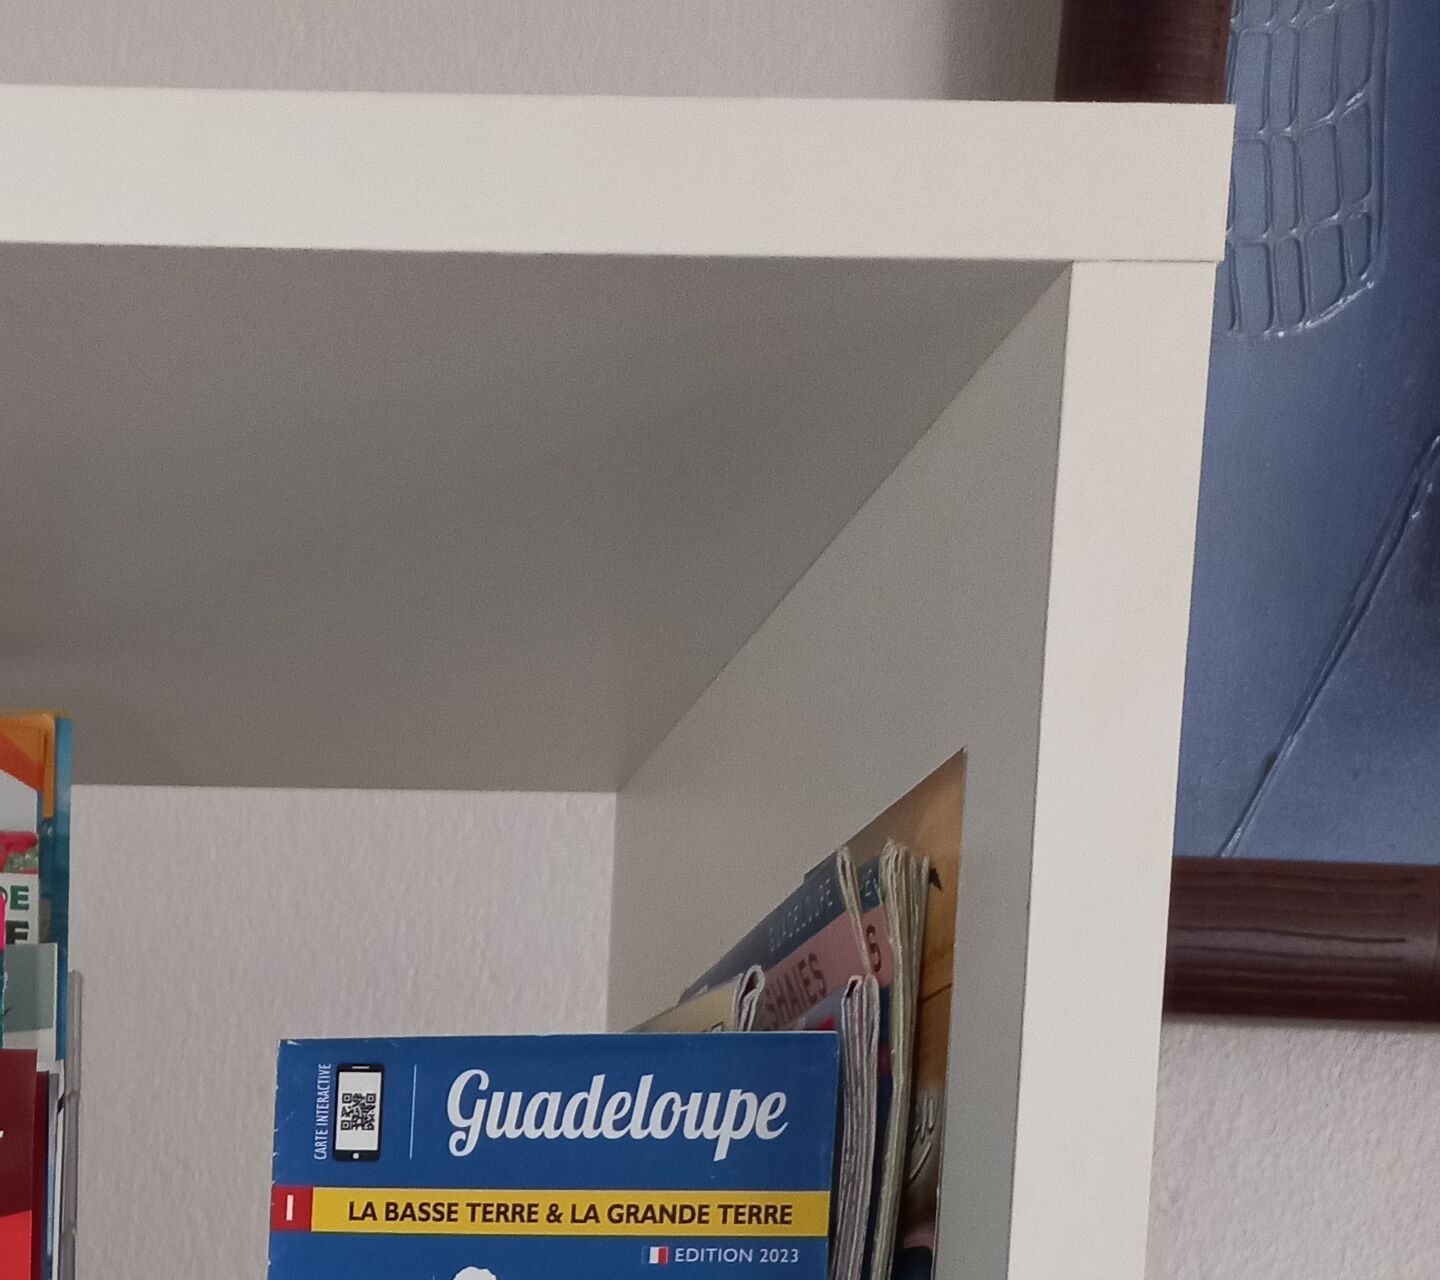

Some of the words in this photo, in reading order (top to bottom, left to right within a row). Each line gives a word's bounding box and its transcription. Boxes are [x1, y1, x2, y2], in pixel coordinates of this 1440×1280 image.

[316, 1063, 332, 1126] INTERACTIVE
[446, 1068, 790, 1162] Guadeloupe
[313, 1128, 328, 1160] CARTE
[348, 1200, 380, 1222] LA
[385, 1201, 459, 1223] BASSE
[466, 1202, 539, 1224] TERRE
[546, 1202, 564, 1224] &
[570, 1203, 602, 1224] LA
[606, 1203, 711, 1226] GRANDE
[717, 1204, 792, 1226] TERRE
[675, 1247, 753, 1264] EDITION
[759, 1248, 800, 1264] 2023
